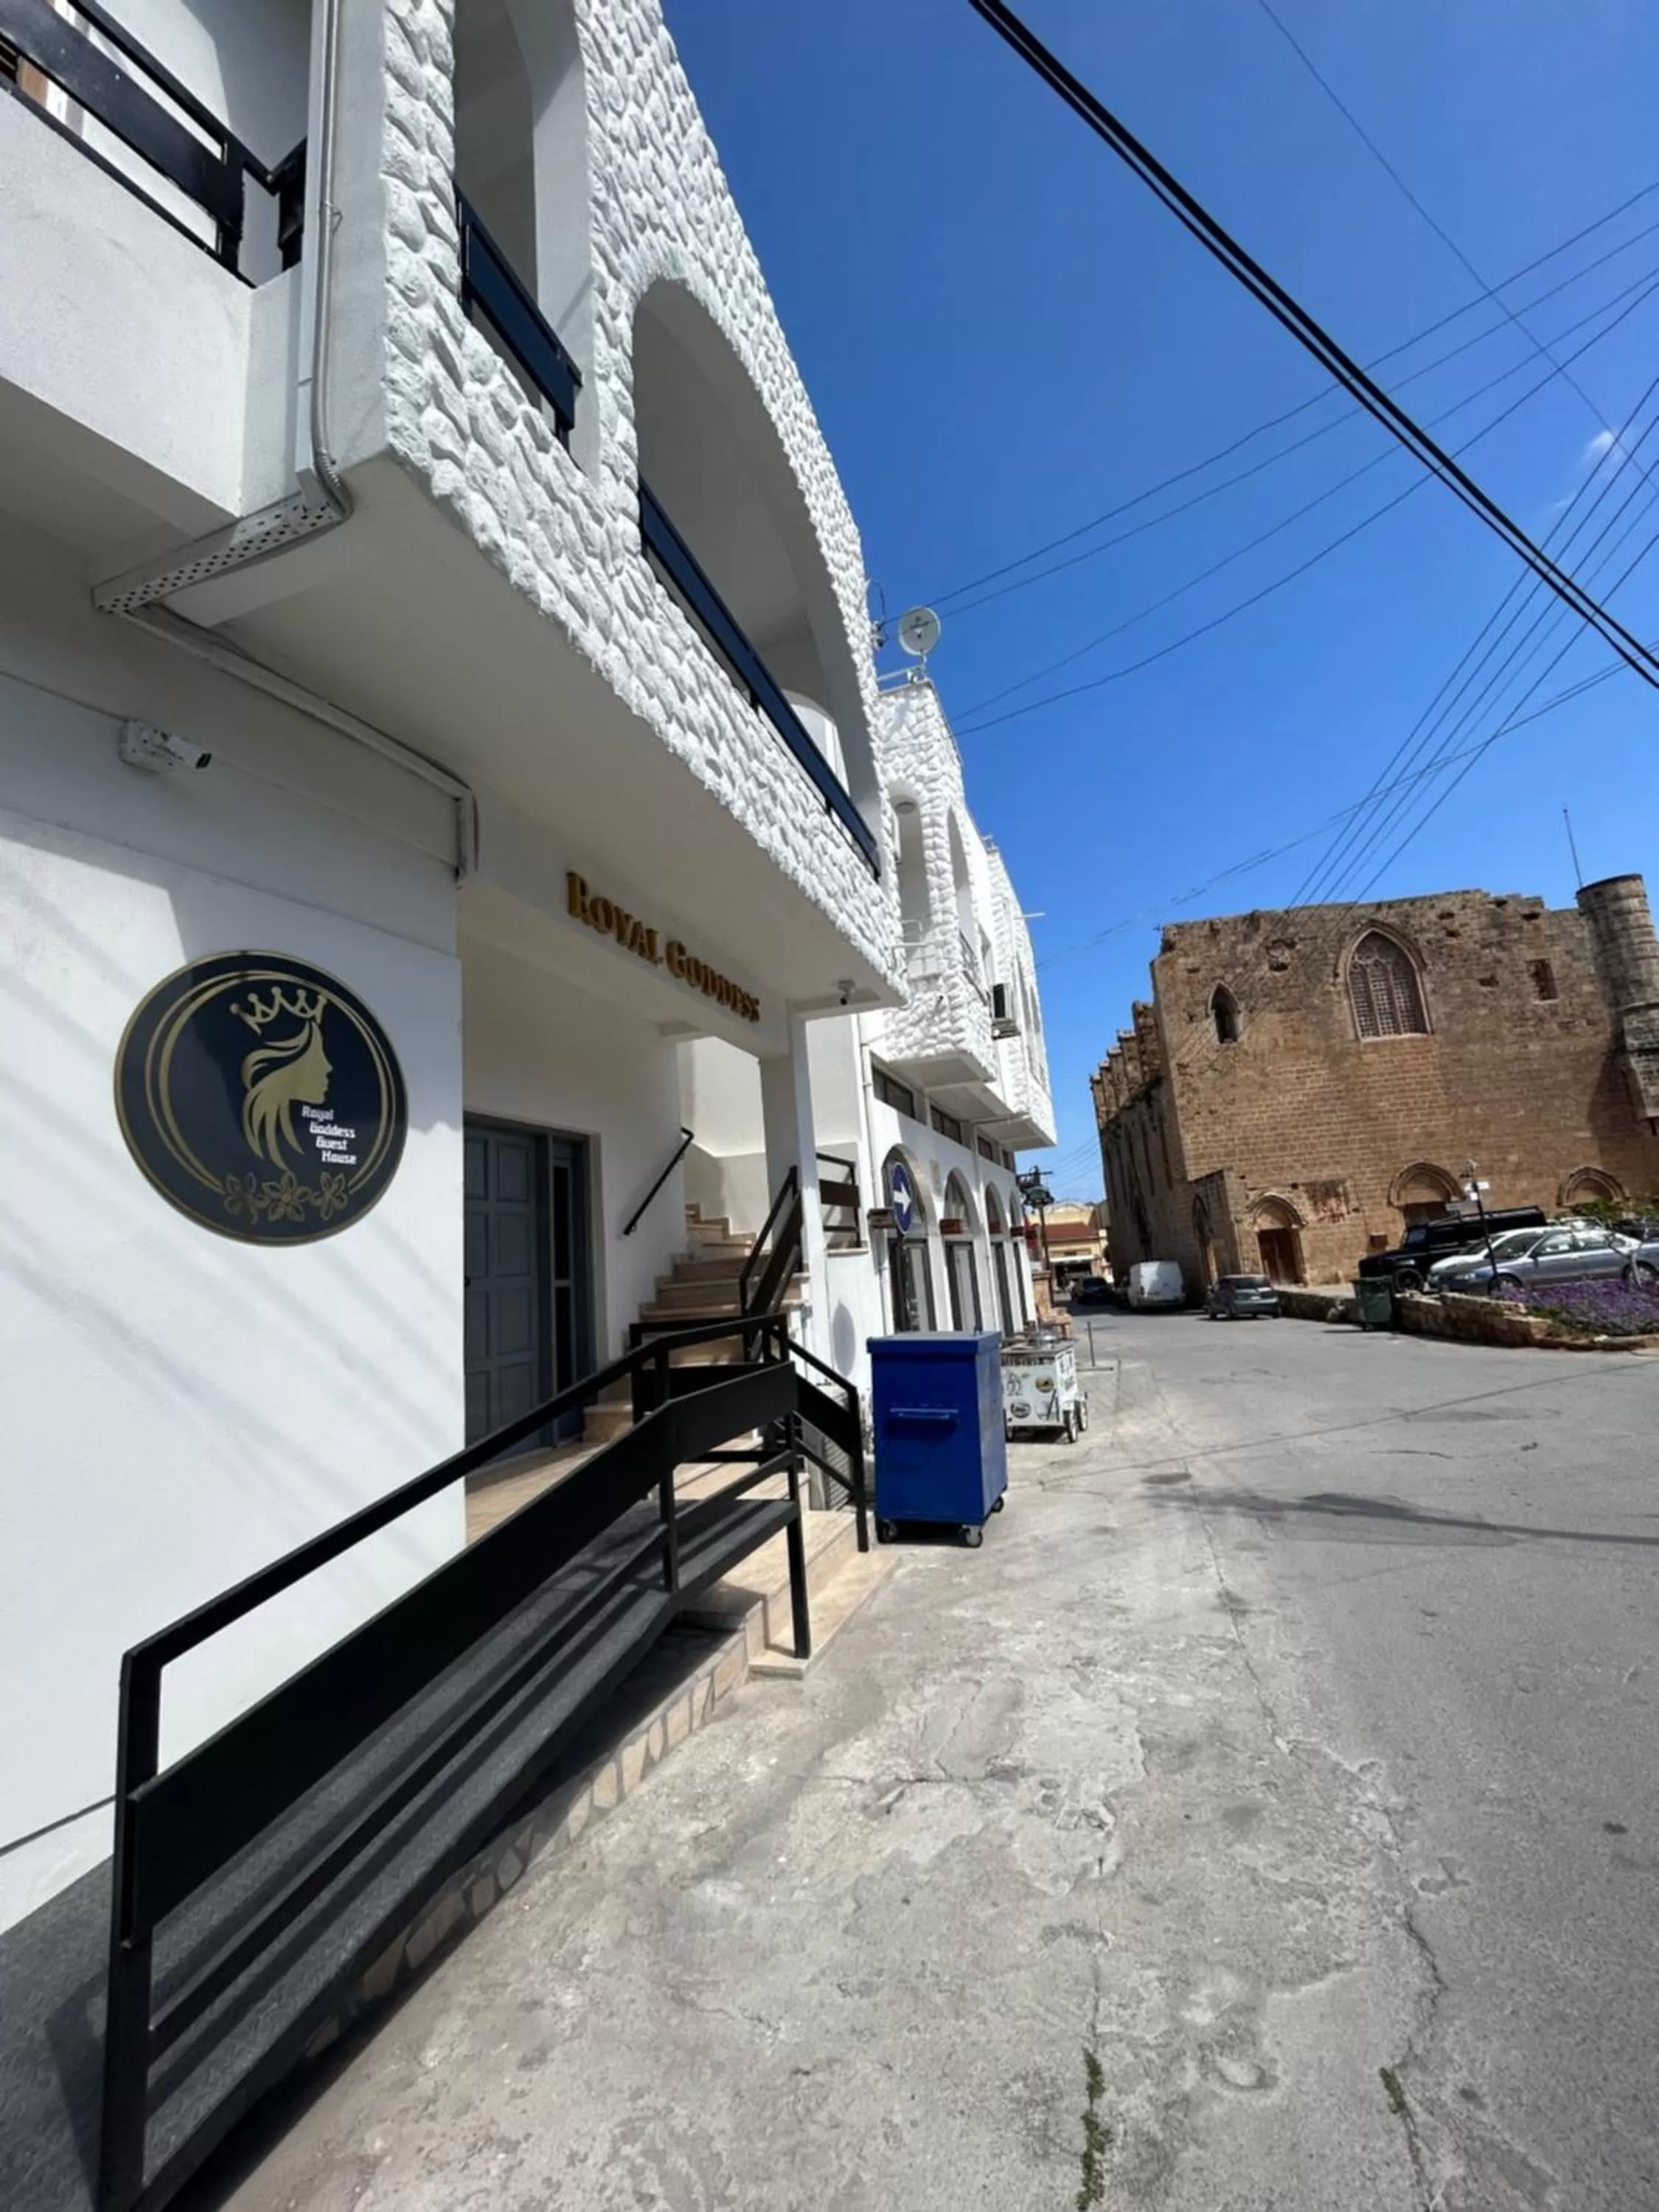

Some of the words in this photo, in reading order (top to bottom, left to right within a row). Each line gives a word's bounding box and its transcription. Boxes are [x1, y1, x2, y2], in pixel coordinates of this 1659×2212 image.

[566, 871, 663, 964] ROYAL
[302, 1105, 334, 1121] Royal
[310, 1121, 356, 1138] Goddess
[316, 1135, 347, 1150] Guest
[321, 1150, 357, 1165] House
